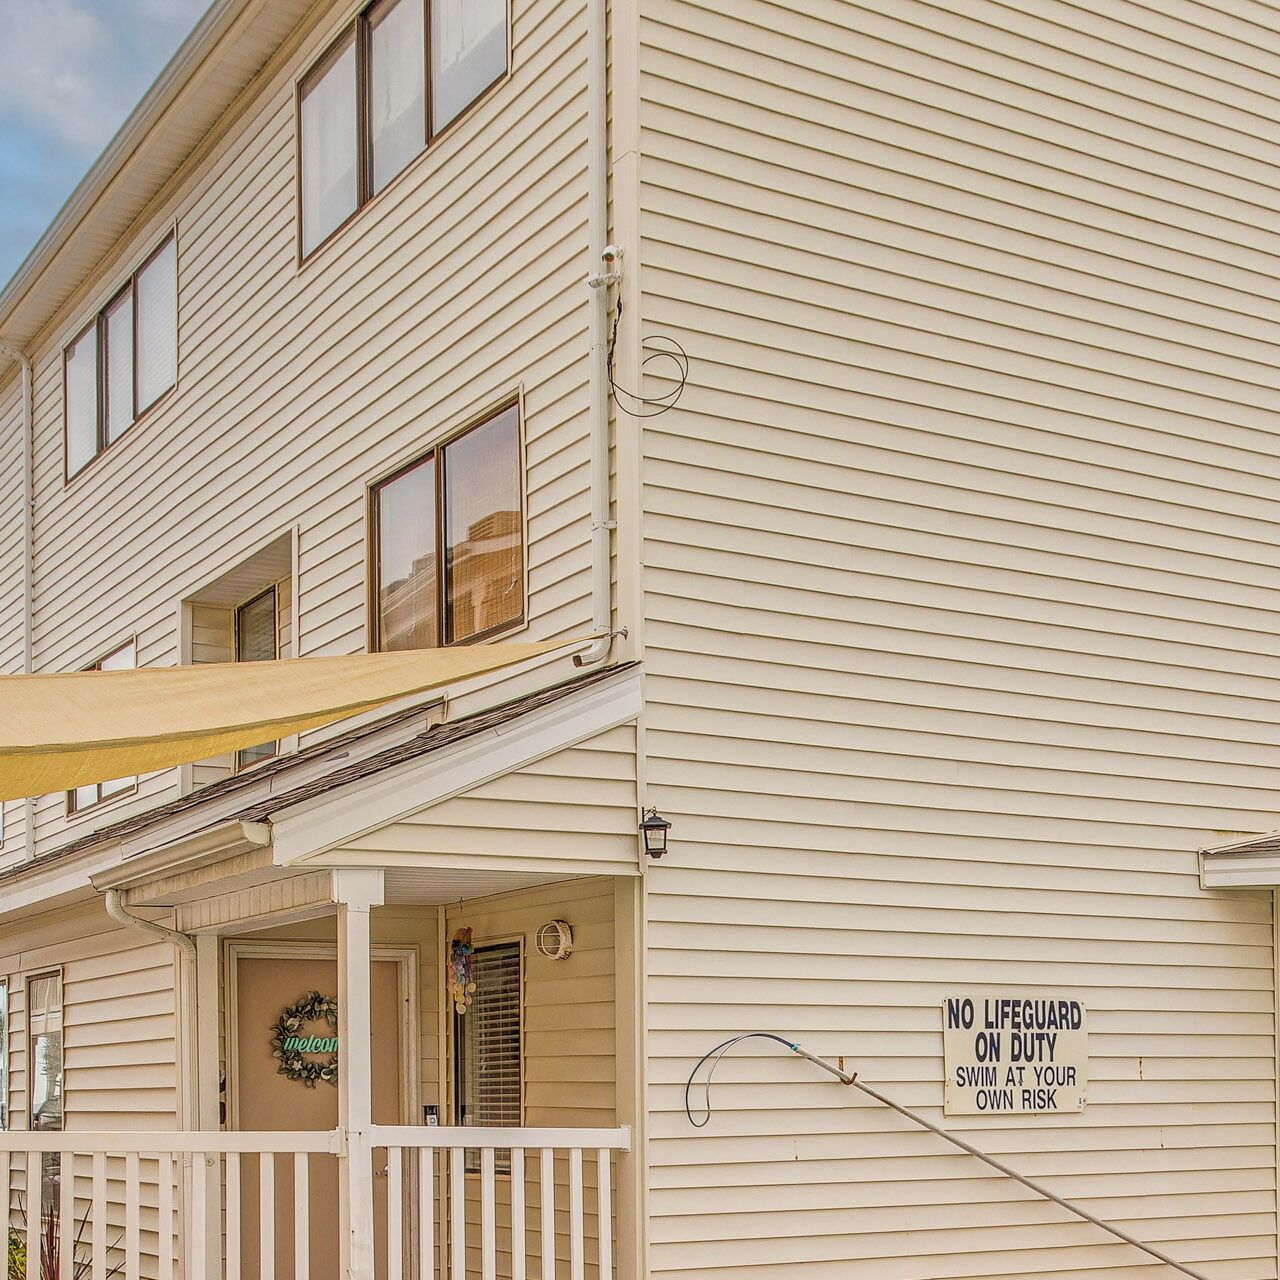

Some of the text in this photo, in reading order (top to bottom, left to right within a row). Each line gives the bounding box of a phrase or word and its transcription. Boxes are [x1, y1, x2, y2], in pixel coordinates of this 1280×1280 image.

[947, 998, 1082, 1030] NO LIFEGUARD
[975, 1032, 1057, 1062] ON DUTY
[956, 1066, 1076, 1087] SWIM AT YOUR
[976, 1089, 1013, 1110] OWN
[1022, 1089, 1057, 1110] RISK
